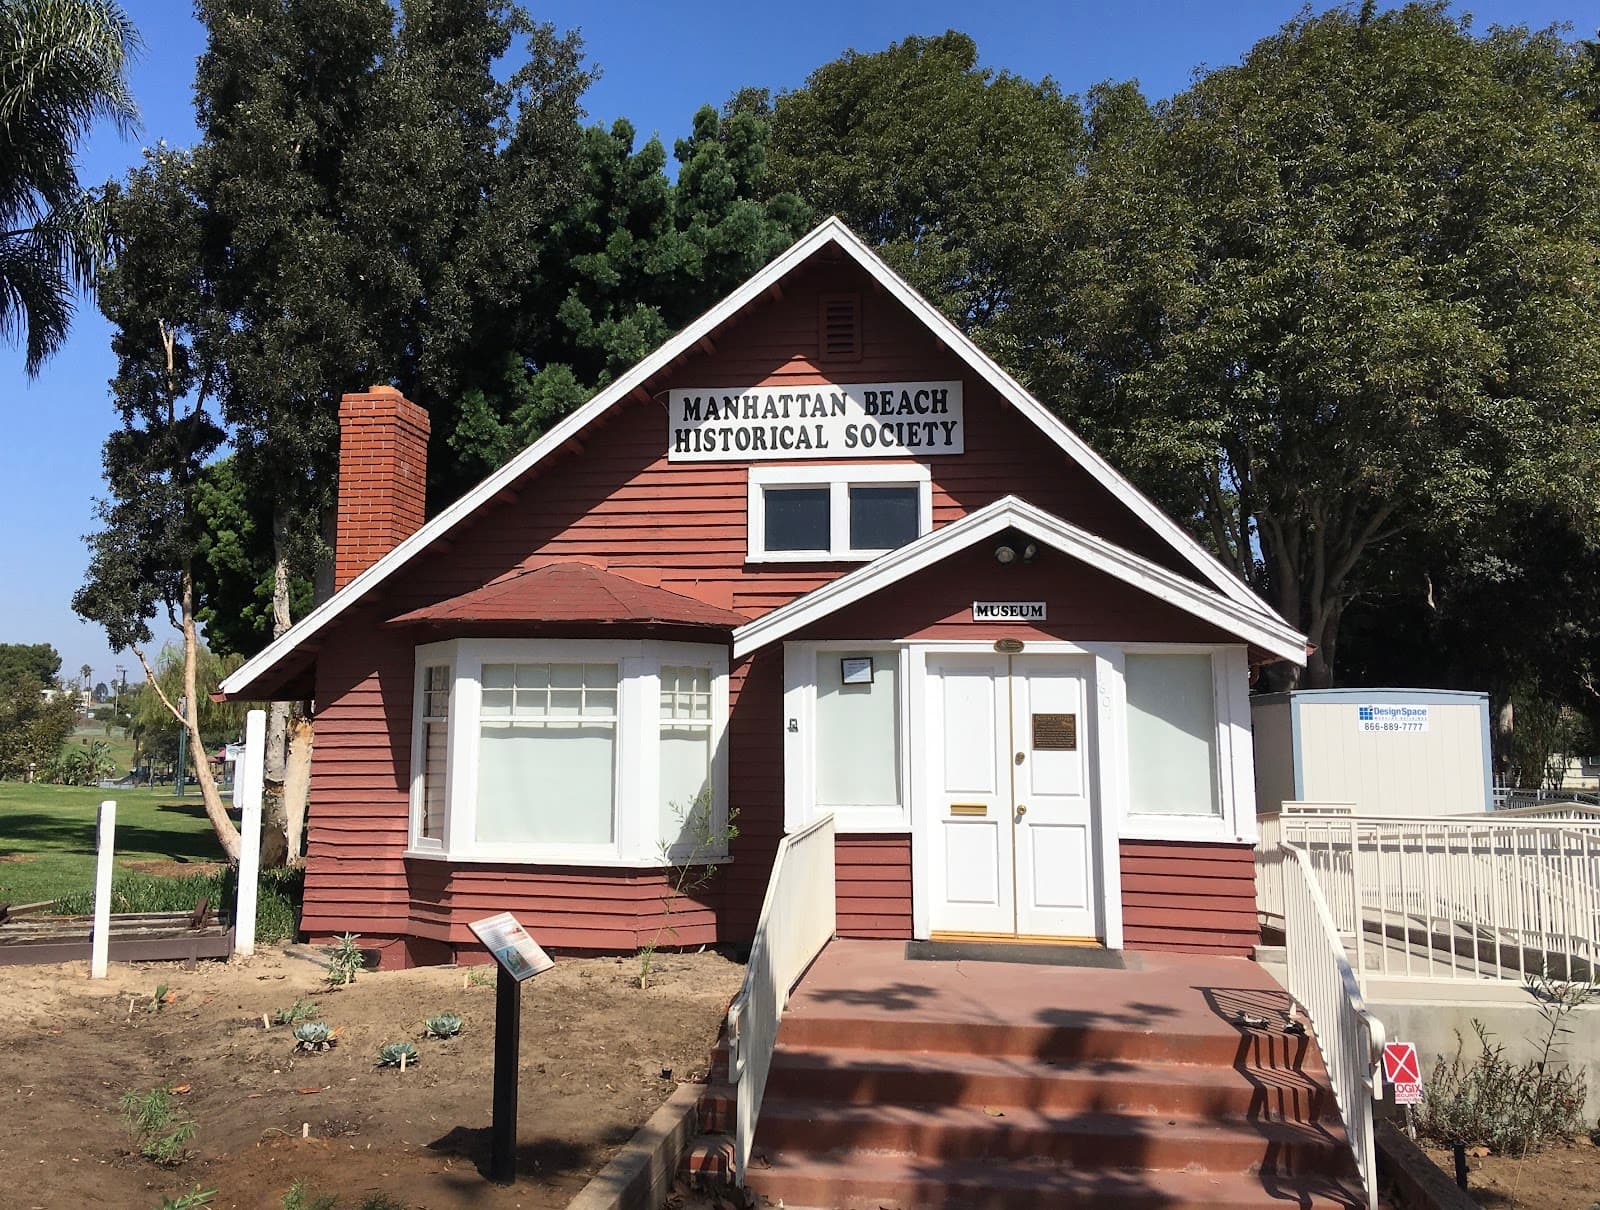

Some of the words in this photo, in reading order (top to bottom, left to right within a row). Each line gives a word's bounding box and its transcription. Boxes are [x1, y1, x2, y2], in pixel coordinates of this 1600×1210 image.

[683, 391, 848, 421] MANHATTAN
[863, 388, 949, 416] BEACH
[674, 424, 829, 452] HISTORICAL
[844, 420, 958, 448] SOCIETY
[976, 605, 1043, 617] MUSEUM
[1374, 707, 1427, 716] DesignSpace
[1364, 722, 1423, 731] 866-889-7777
[1395, 1083, 1421, 1093] OGIX
